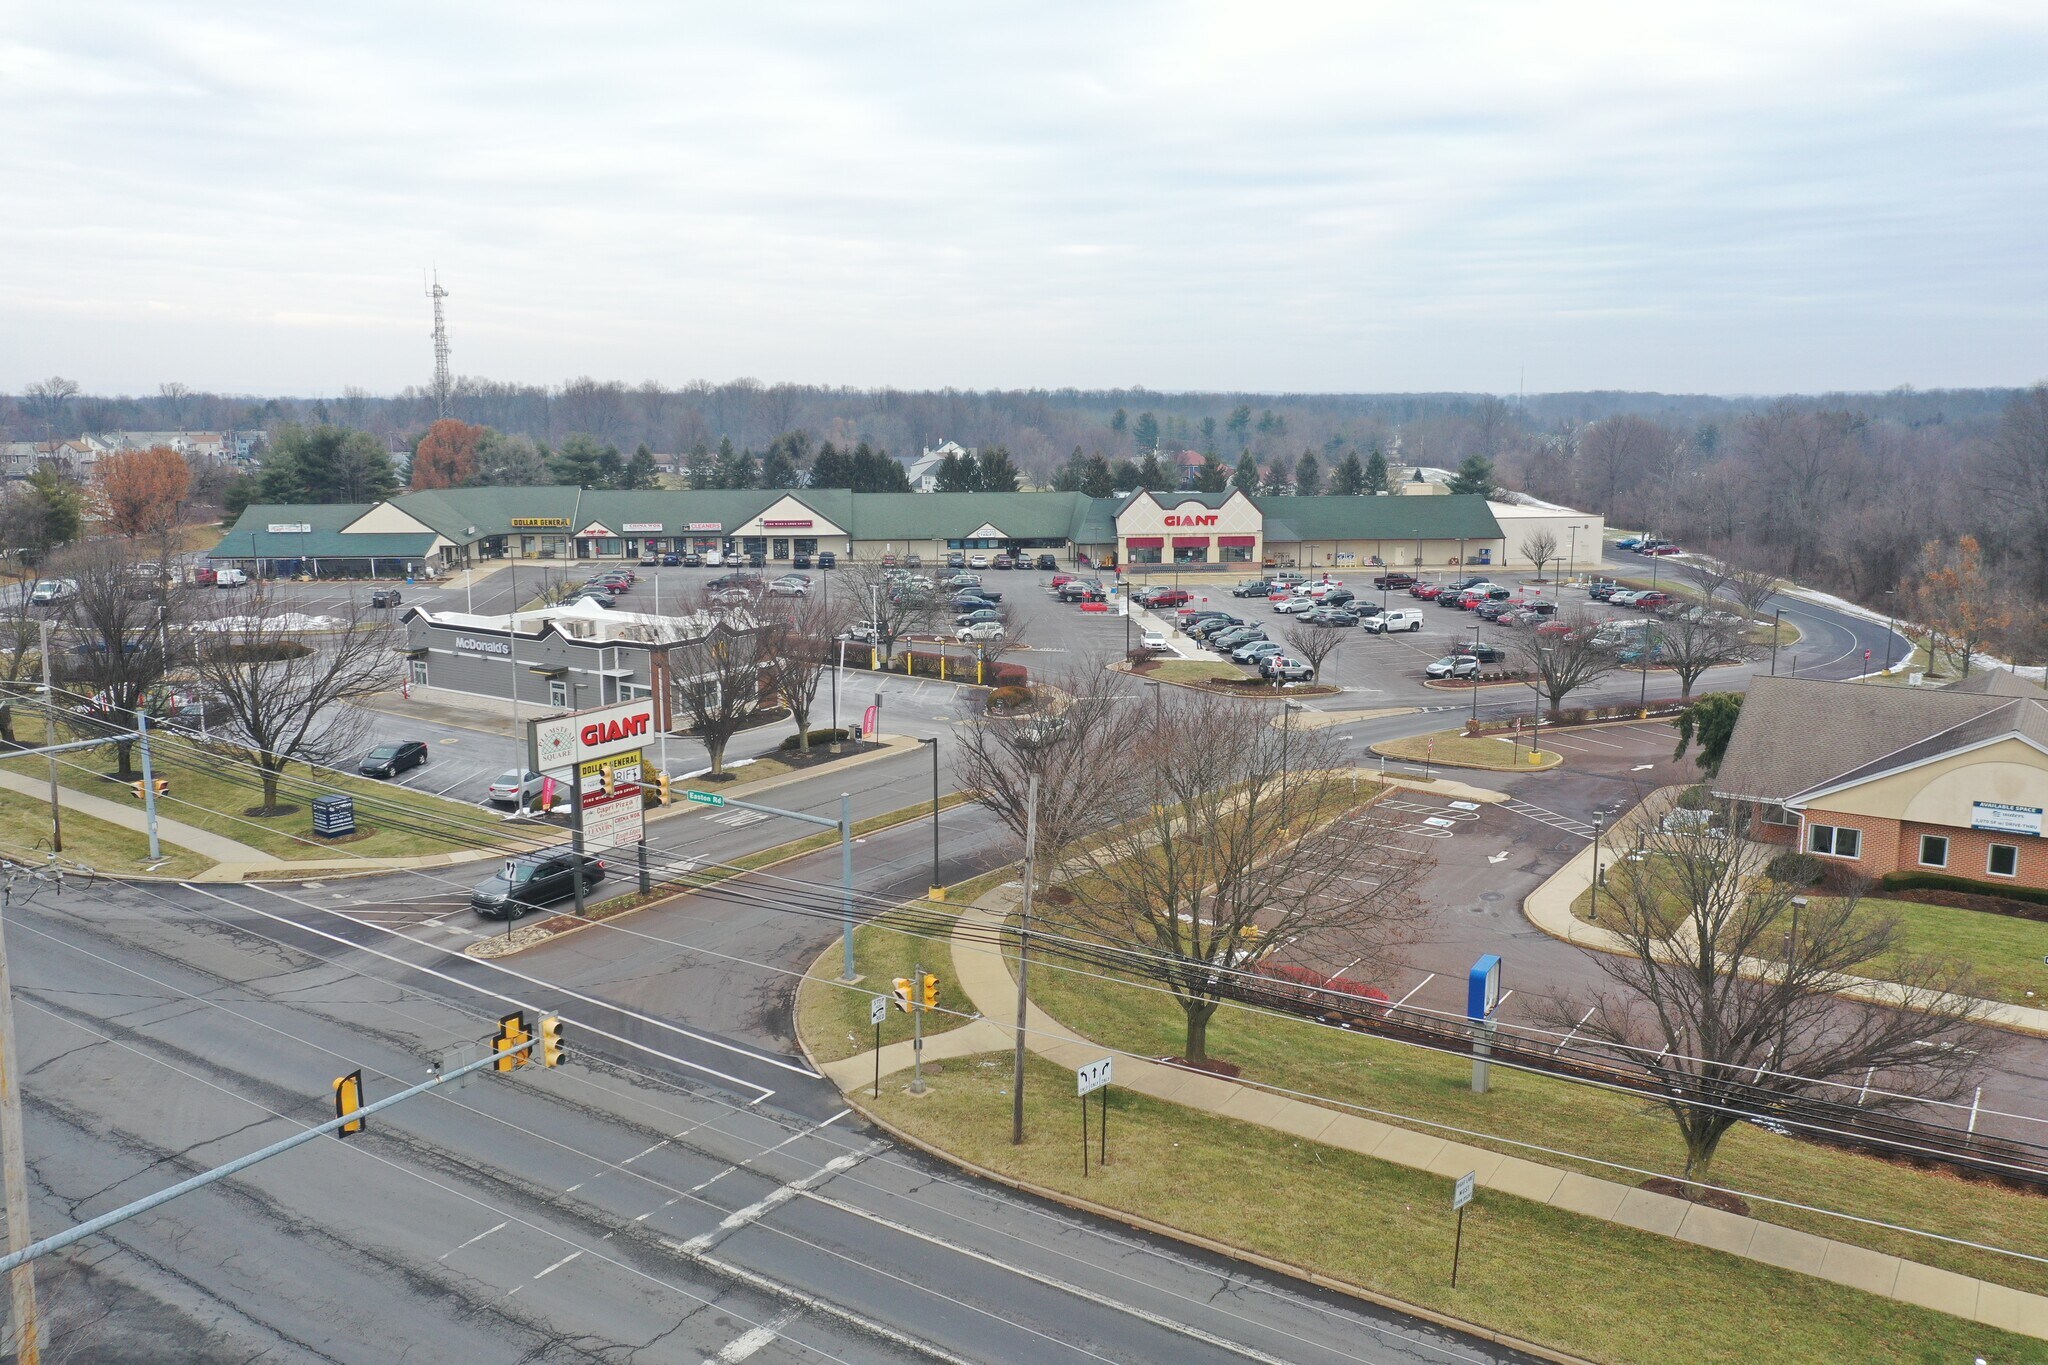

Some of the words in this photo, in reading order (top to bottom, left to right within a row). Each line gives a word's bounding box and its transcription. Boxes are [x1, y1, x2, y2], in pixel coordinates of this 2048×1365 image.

[1164, 516, 1218, 526] GIANT
[455, 637, 509, 654] McDonald's
[581, 713, 650, 747] GIANT
[543, 750, 572, 761] SQUARE
[689, 792, 711, 802] Easton
[712, 796, 722, 804] Rd
[616, 800, 633, 809] Pizza
[1980, 802, 2014, 810] AVAILABLE
